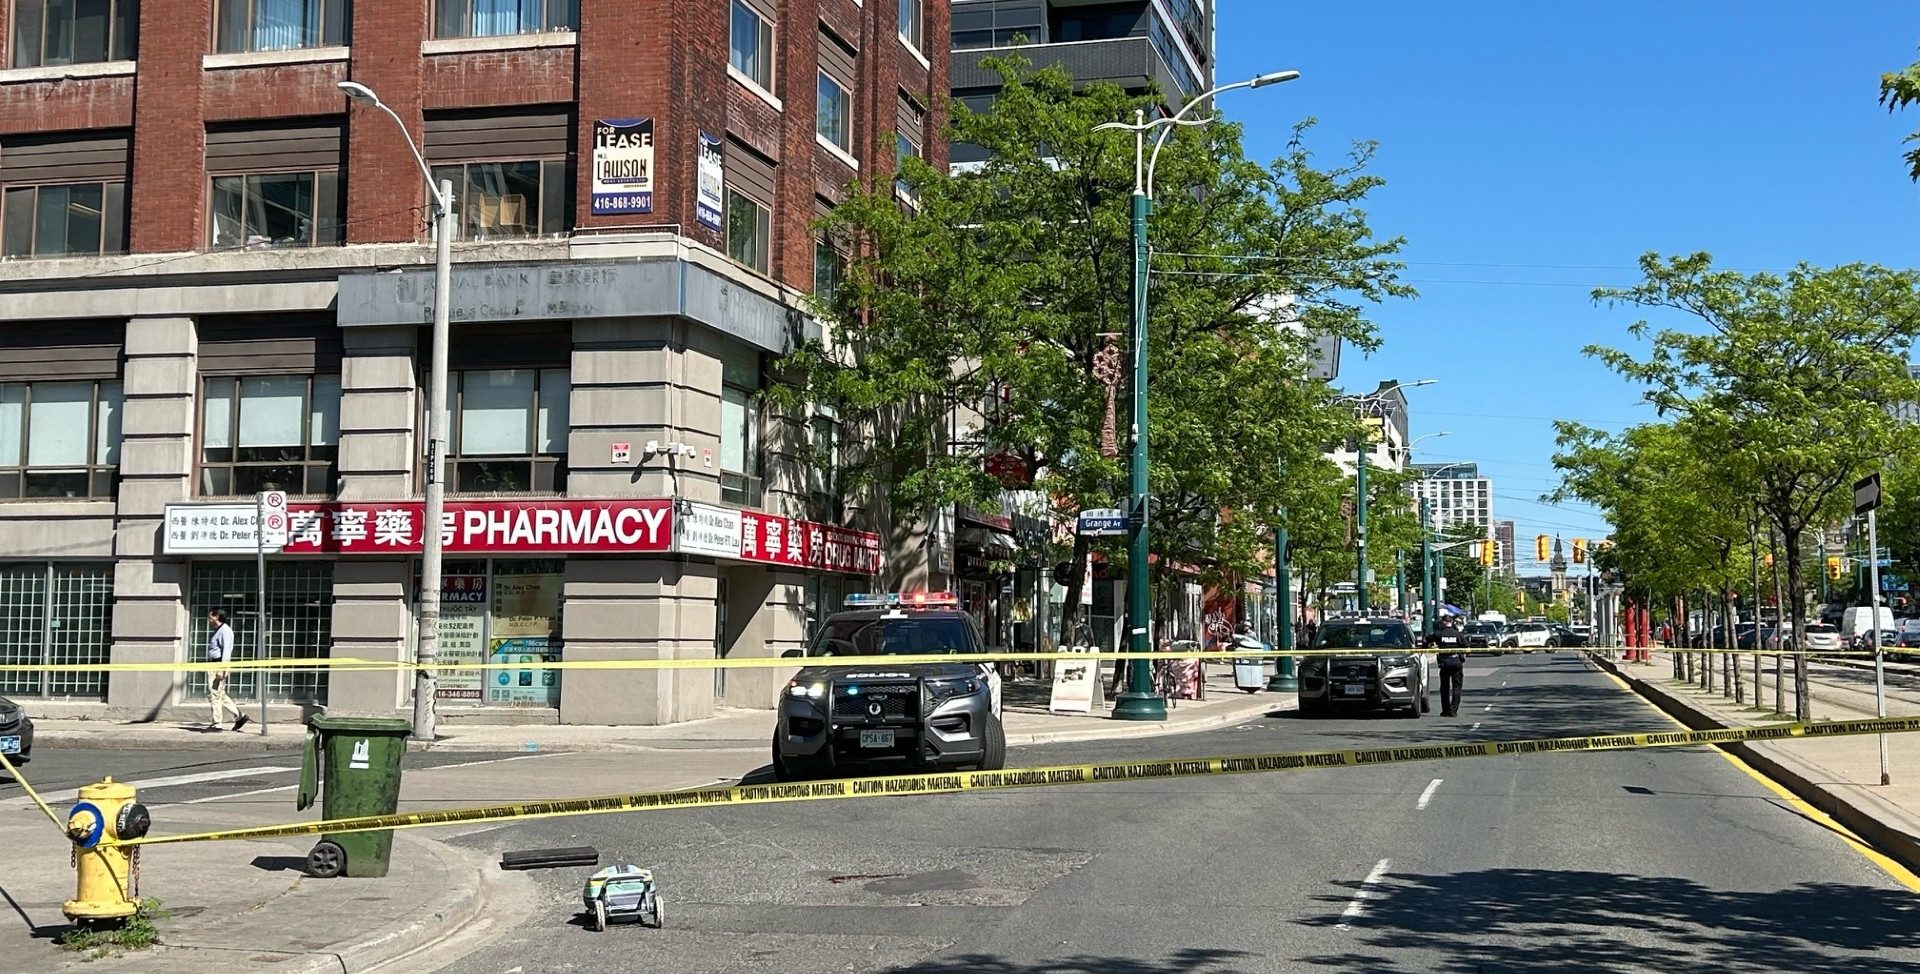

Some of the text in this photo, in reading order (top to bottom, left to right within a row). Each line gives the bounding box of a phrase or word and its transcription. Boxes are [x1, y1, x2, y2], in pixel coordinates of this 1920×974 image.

[597, 127, 615, 135] FOR
[597, 133, 651, 149] LEASE
[597, 159, 647, 180] LAWSON
[594, 195, 651, 209] 416-868-9901
[232, 516, 248, 525] Alex
[463, 508, 669, 545] PHARMACY
[1085, 519, 1112, 529] Grange
[231, 530, 251, 540] Peter
[825, 541, 852, 568] DRUG
[629, 795, 659, 807] CAUTION
[661, 793, 698, 805] HAZARDOUS
[700, 790, 732, 802] MATERIAL
[740, 788, 769, 799] CAUTION
[771, 784, 809, 798] HAZARDOUS
[812, 783, 844, 795] MATERIAL
[853, 781, 883, 793] CAUTION
[885, 778, 925, 792] HAZARDOUS
[927, 776, 962, 790] MATERIAL
[970, 774, 1001, 787] CAUTION
[1004, 771, 1046, 785] HAZARDOUS
[1049, 769, 1084, 782] MATERIAL
[1092, 766, 1126, 779] CAUTION
[1128, 764, 1171, 777] HAZARDOUS
[1174, 761, 1212, 775] MATERIAL
[1220, 759, 1256, 772] CAUTION
[1257, 756, 1303, 769] HAZARDOUS
[1305, 753, 1346, 766] MATERIAL
[1355, 751, 1392, 763] CAUTION
[1394, 748, 1443, 761] HAZARDOUS
[1445, 745, 1487, 757] MATERIAL
[1496, 742, 1535, 754] CAUTION
[1537, 739, 1589, 750] HAZARDOUS
[1591, 736, 1637, 747] MATERIAL
[1647, 733, 1687, 745] CAUTION
[1690, 730, 1744, 742] HAZARDOUS
[1747, 727, 1793, 738] MATERIAL
[1804, 724, 1845, 735] CAUTION
[1848, 721, 1905, 732] HAZARDOUS
